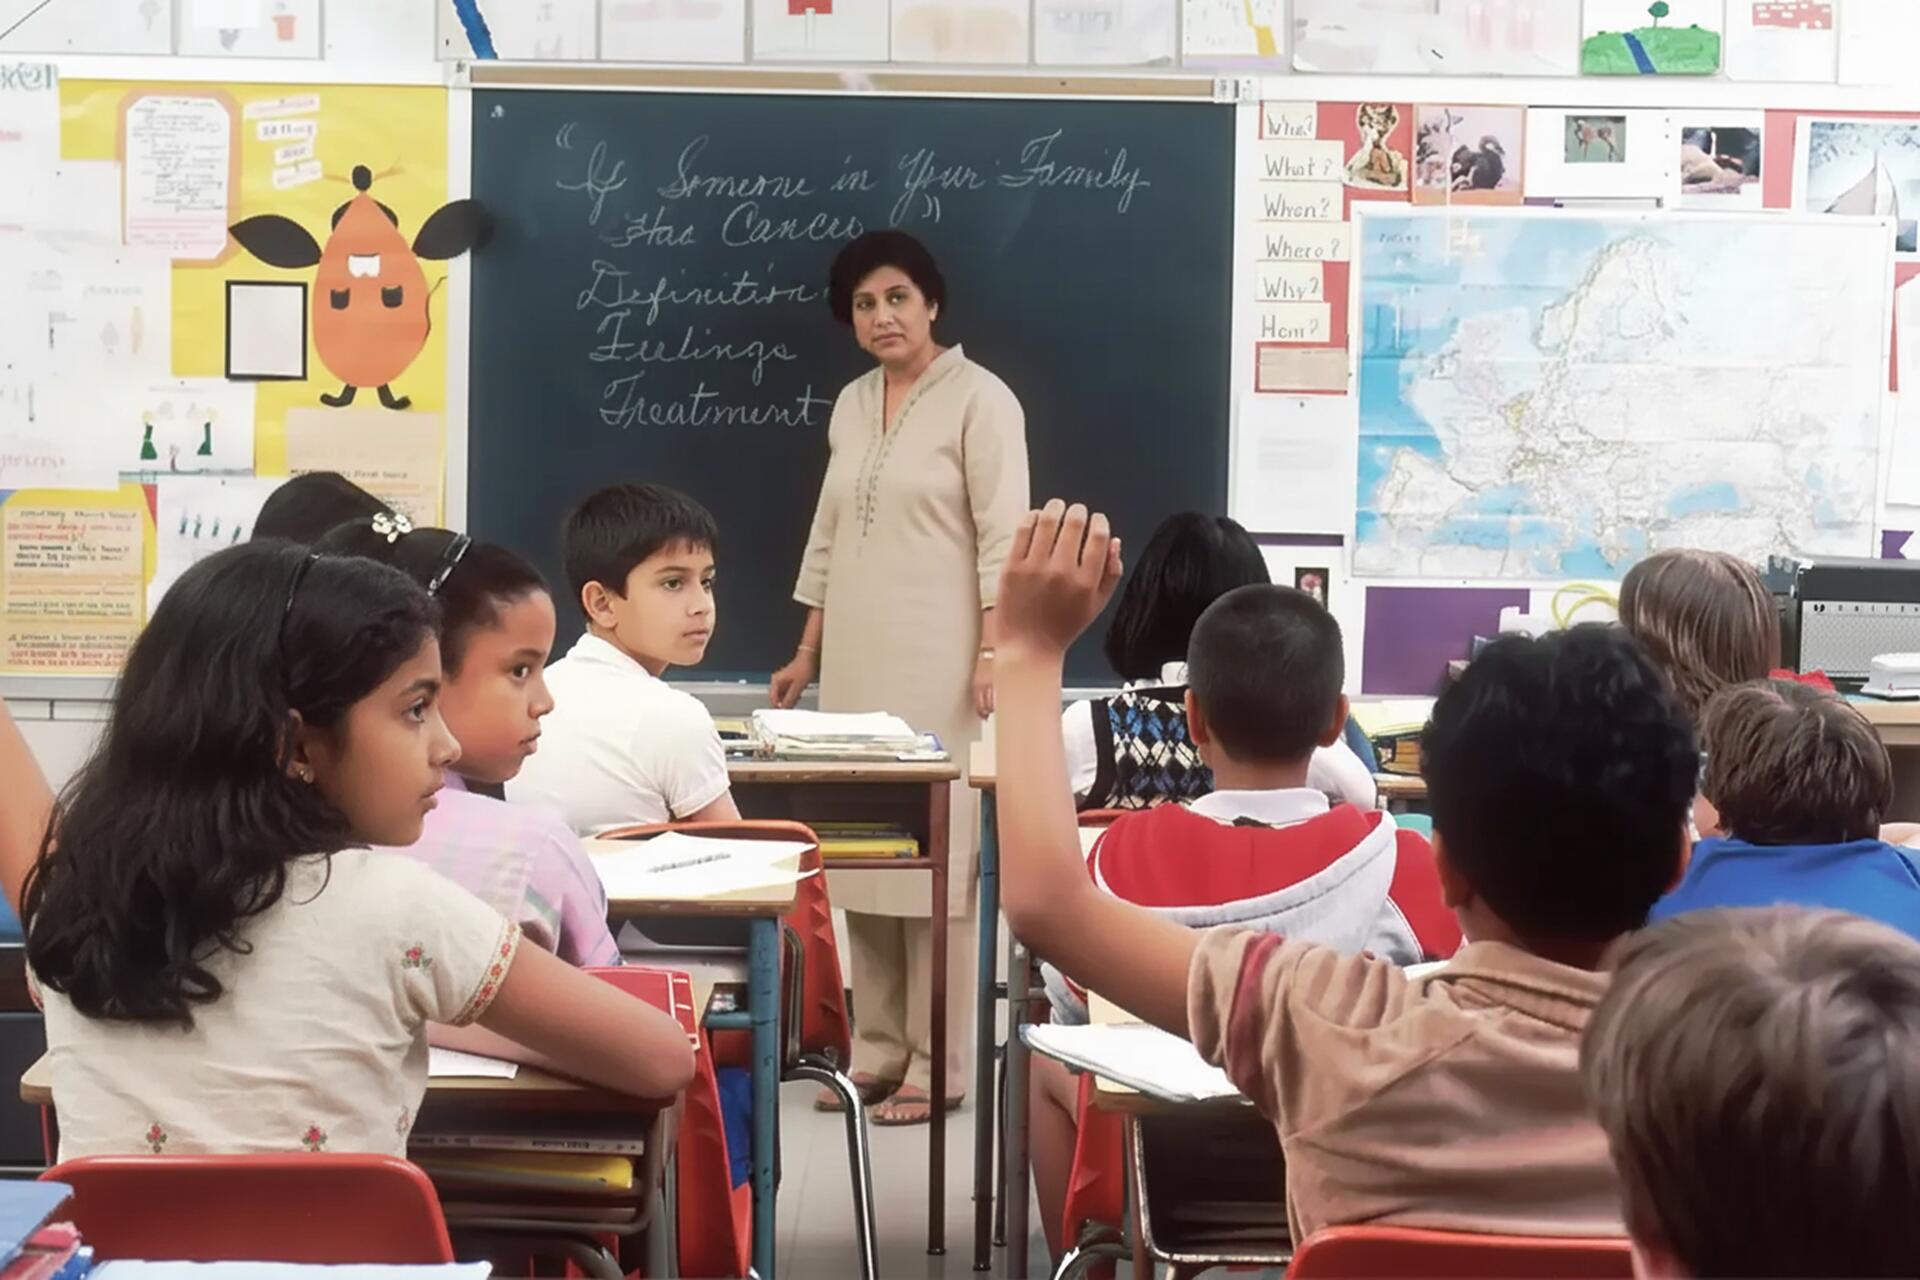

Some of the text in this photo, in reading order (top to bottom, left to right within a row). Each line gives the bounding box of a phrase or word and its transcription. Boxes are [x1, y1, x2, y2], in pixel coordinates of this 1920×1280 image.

[657, 134, 816, 200] Someone
[830, 155, 878, 191] in
[889, 148, 986, 228] Your
[1000, 128, 1151, 213] Family
[604, 206, 697, 248] Has
[589, 308, 798, 386] Feelings
[599, 370, 833, 429] Treatment
